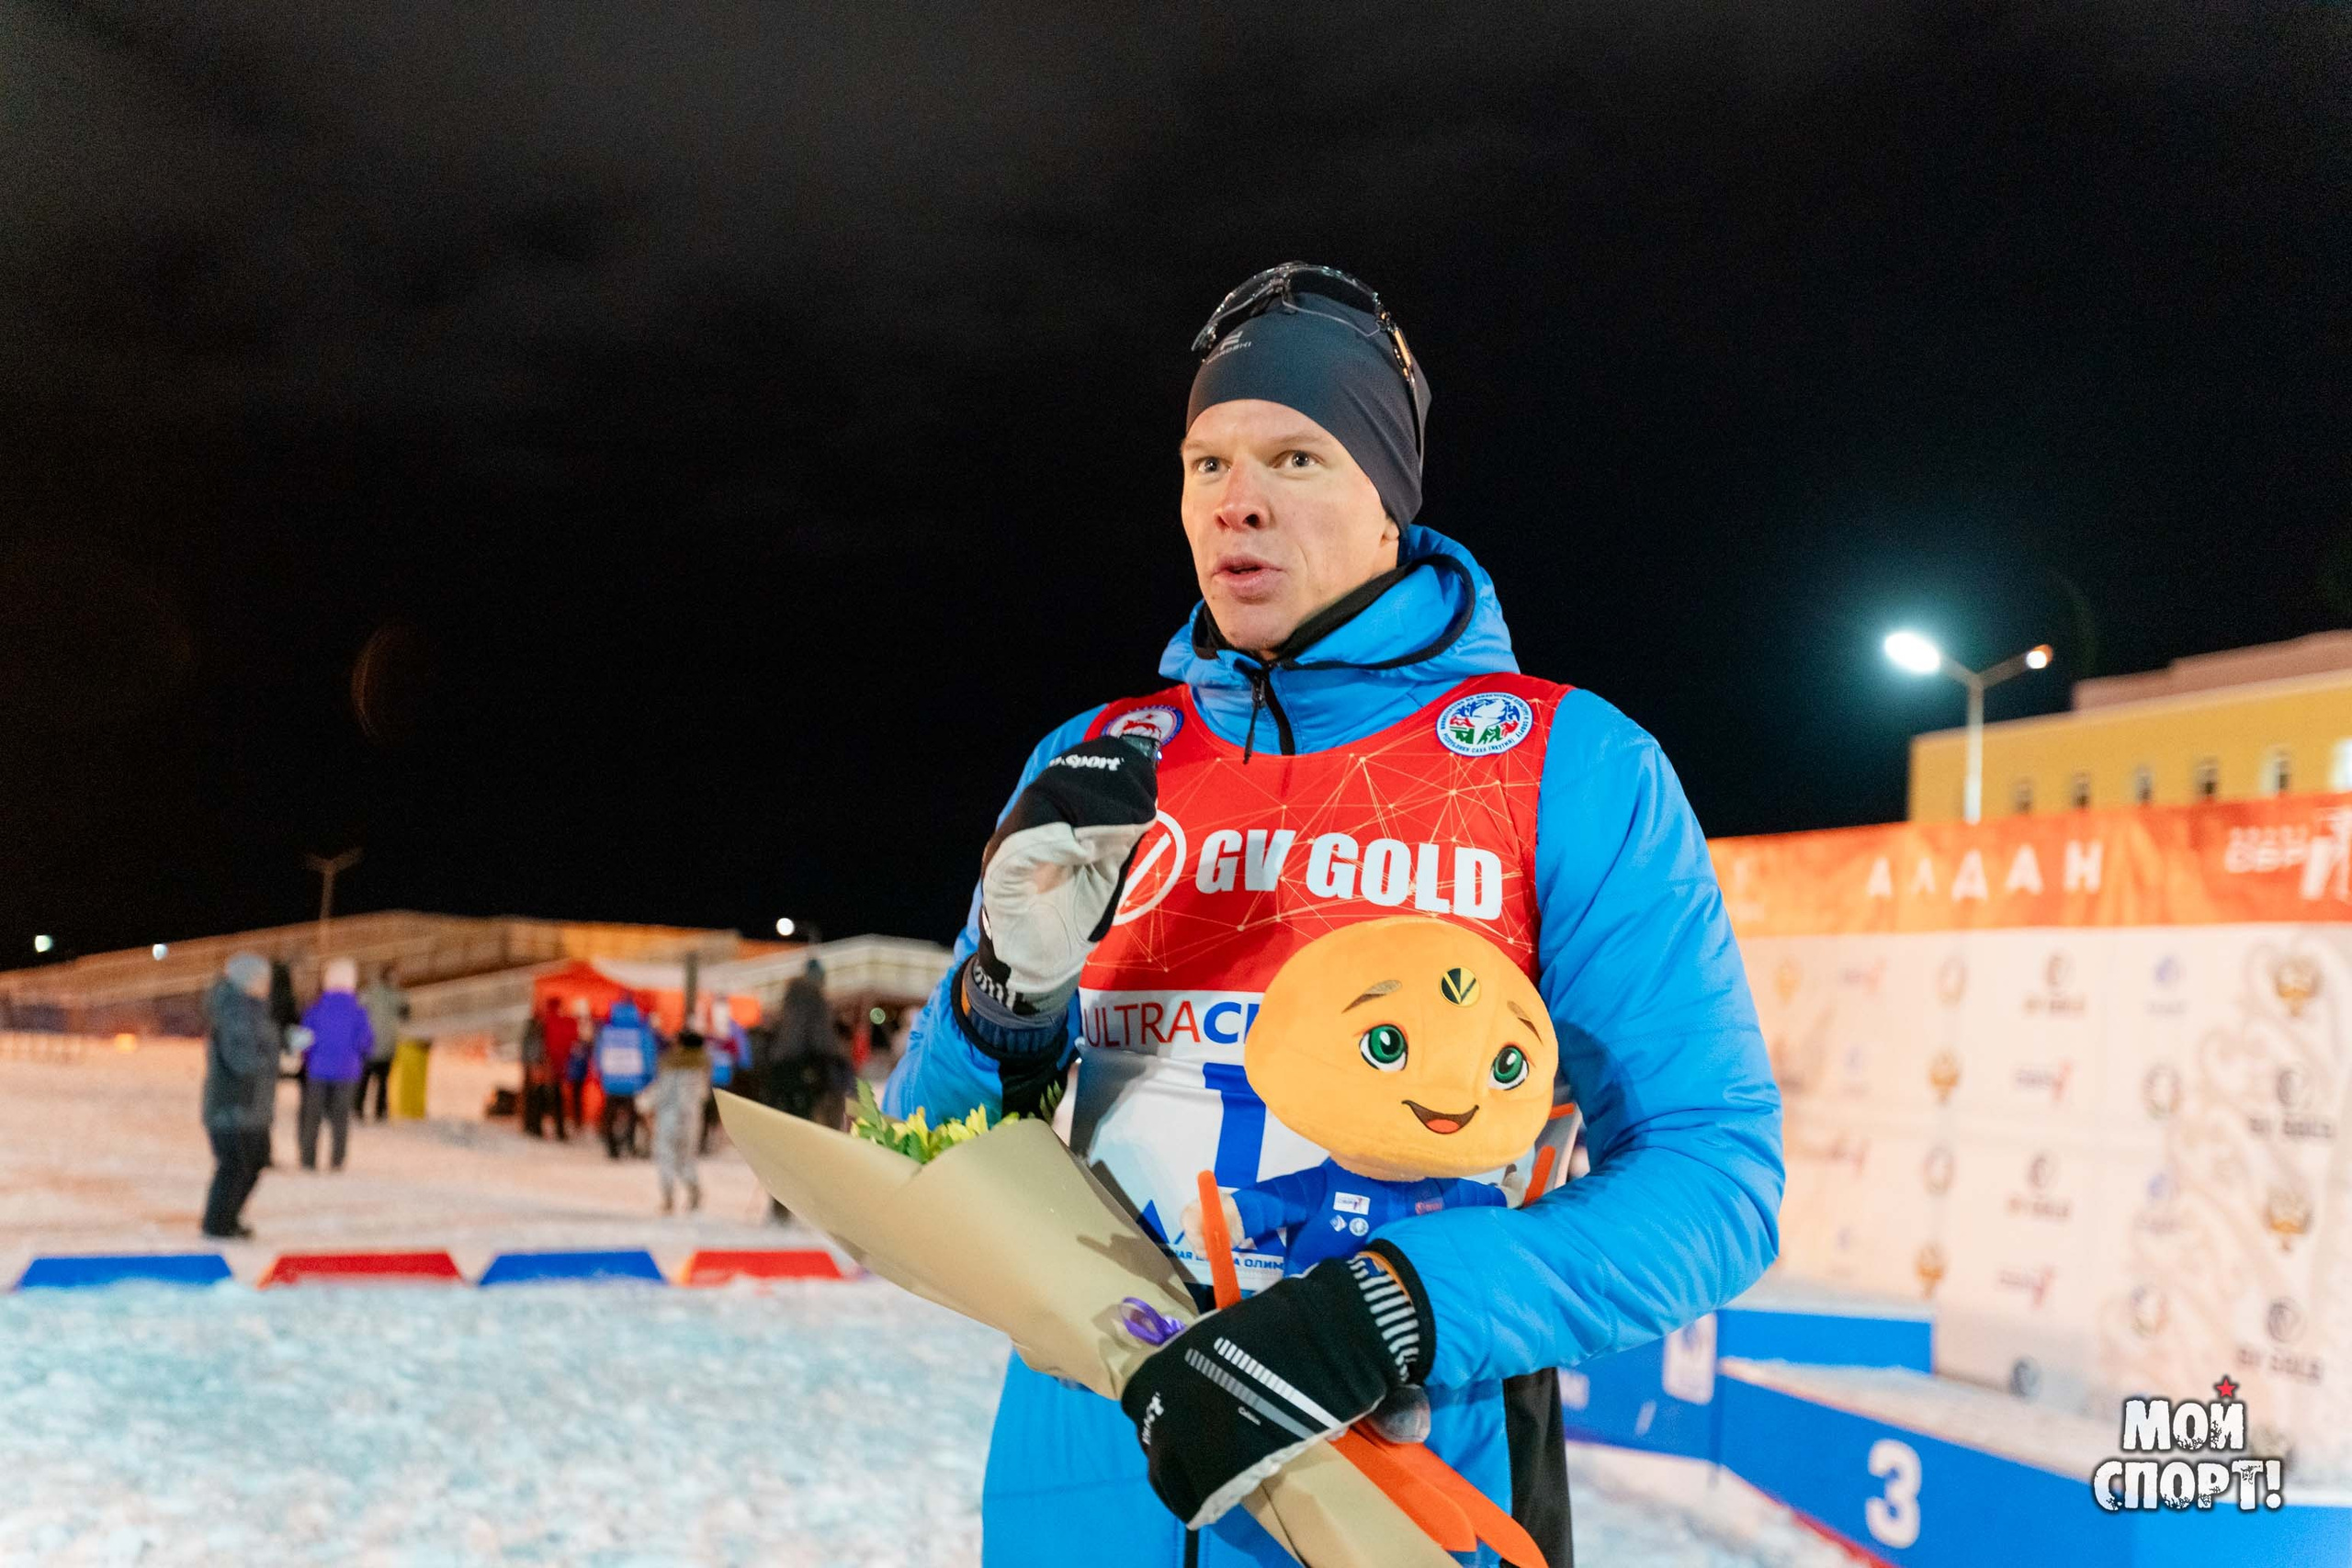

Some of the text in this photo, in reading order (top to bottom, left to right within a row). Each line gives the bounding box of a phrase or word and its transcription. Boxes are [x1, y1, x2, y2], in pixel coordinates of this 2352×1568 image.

[1195, 829, 1503, 920] GV GOLD
[1866, 840, 2104, 902] АЛДАН
[1865, 1439, 1922, 1550] 3
